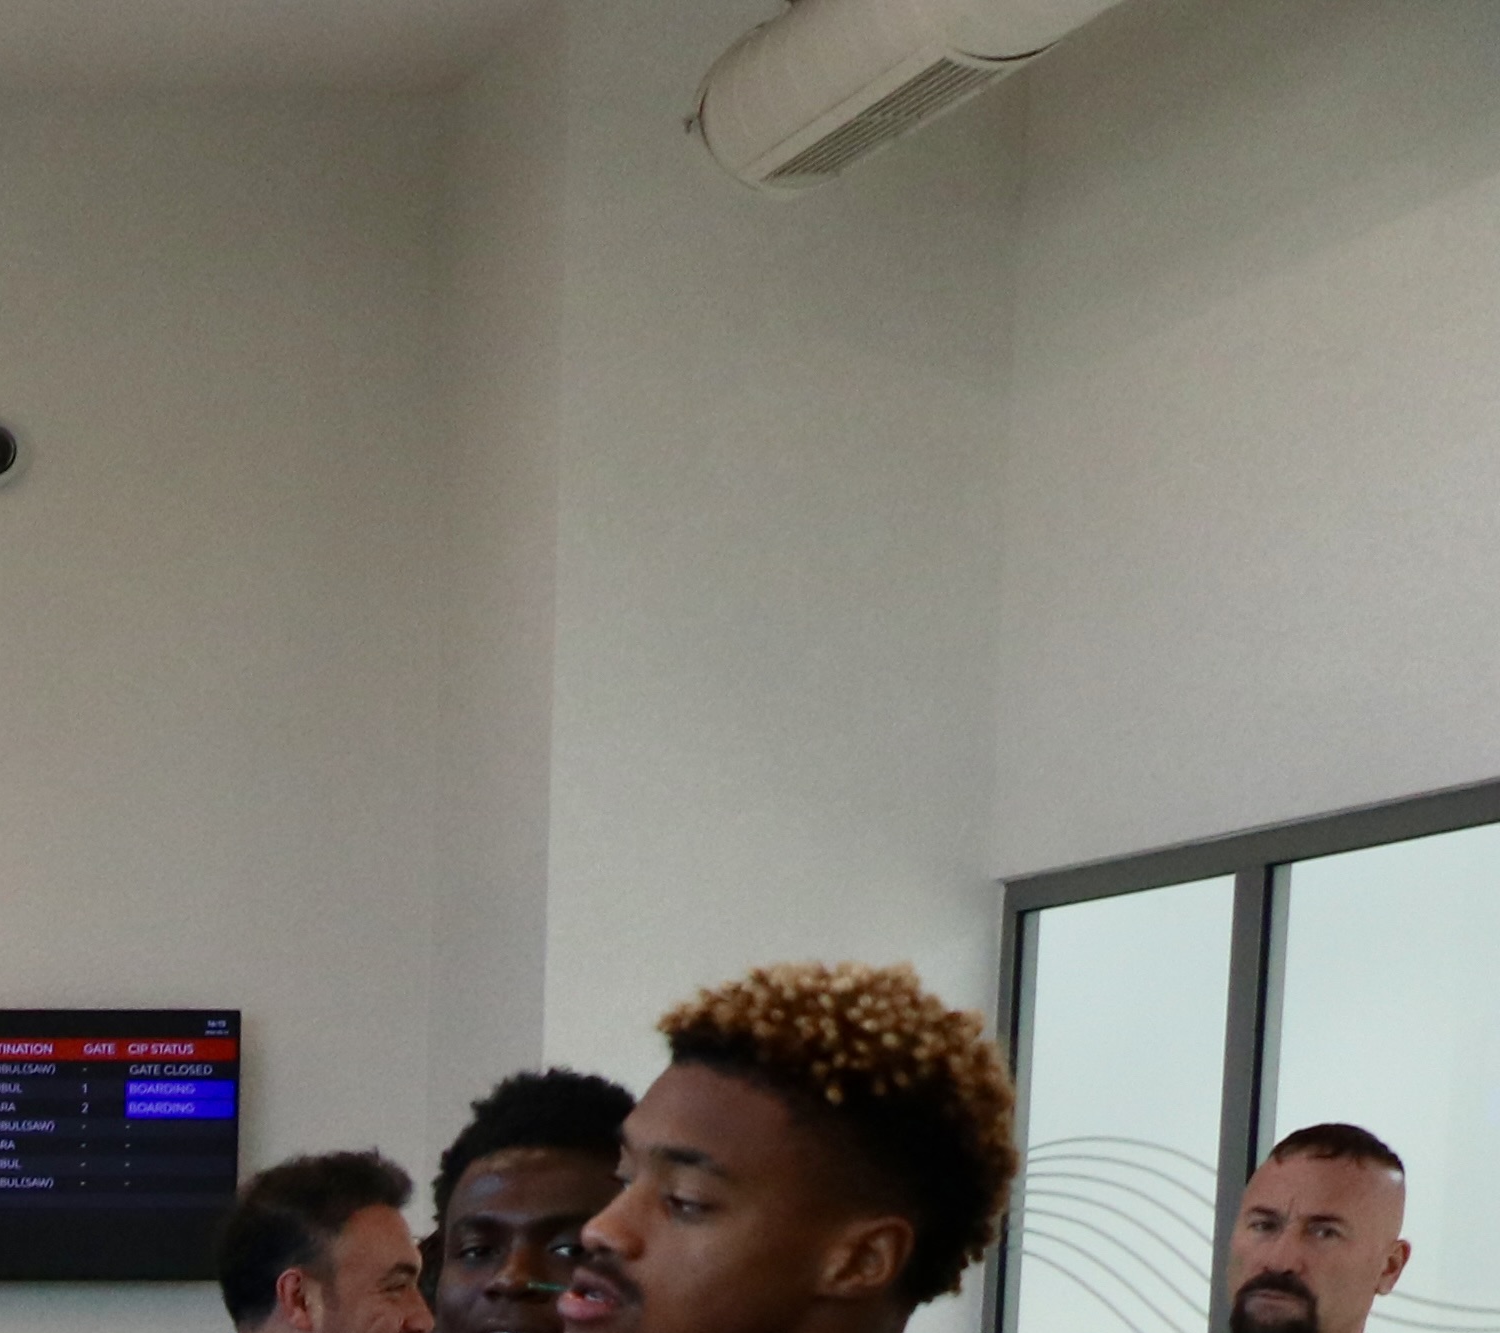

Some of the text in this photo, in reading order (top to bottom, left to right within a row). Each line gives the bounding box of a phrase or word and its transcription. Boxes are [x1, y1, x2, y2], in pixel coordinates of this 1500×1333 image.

[83, 1043, 115, 1055] GATE
[128, 1043, 148, 1055] CIP
[151, 1043, 195, 1055] STATUS
[130, 1065, 161, 1076] GATE
[163, 1065, 213, 1076] CLOSED
[128, 1083, 196, 1095] BOARDING
[81, 1102, 89, 1113] 2
[128, 1102, 196, 1114] BOARDING
